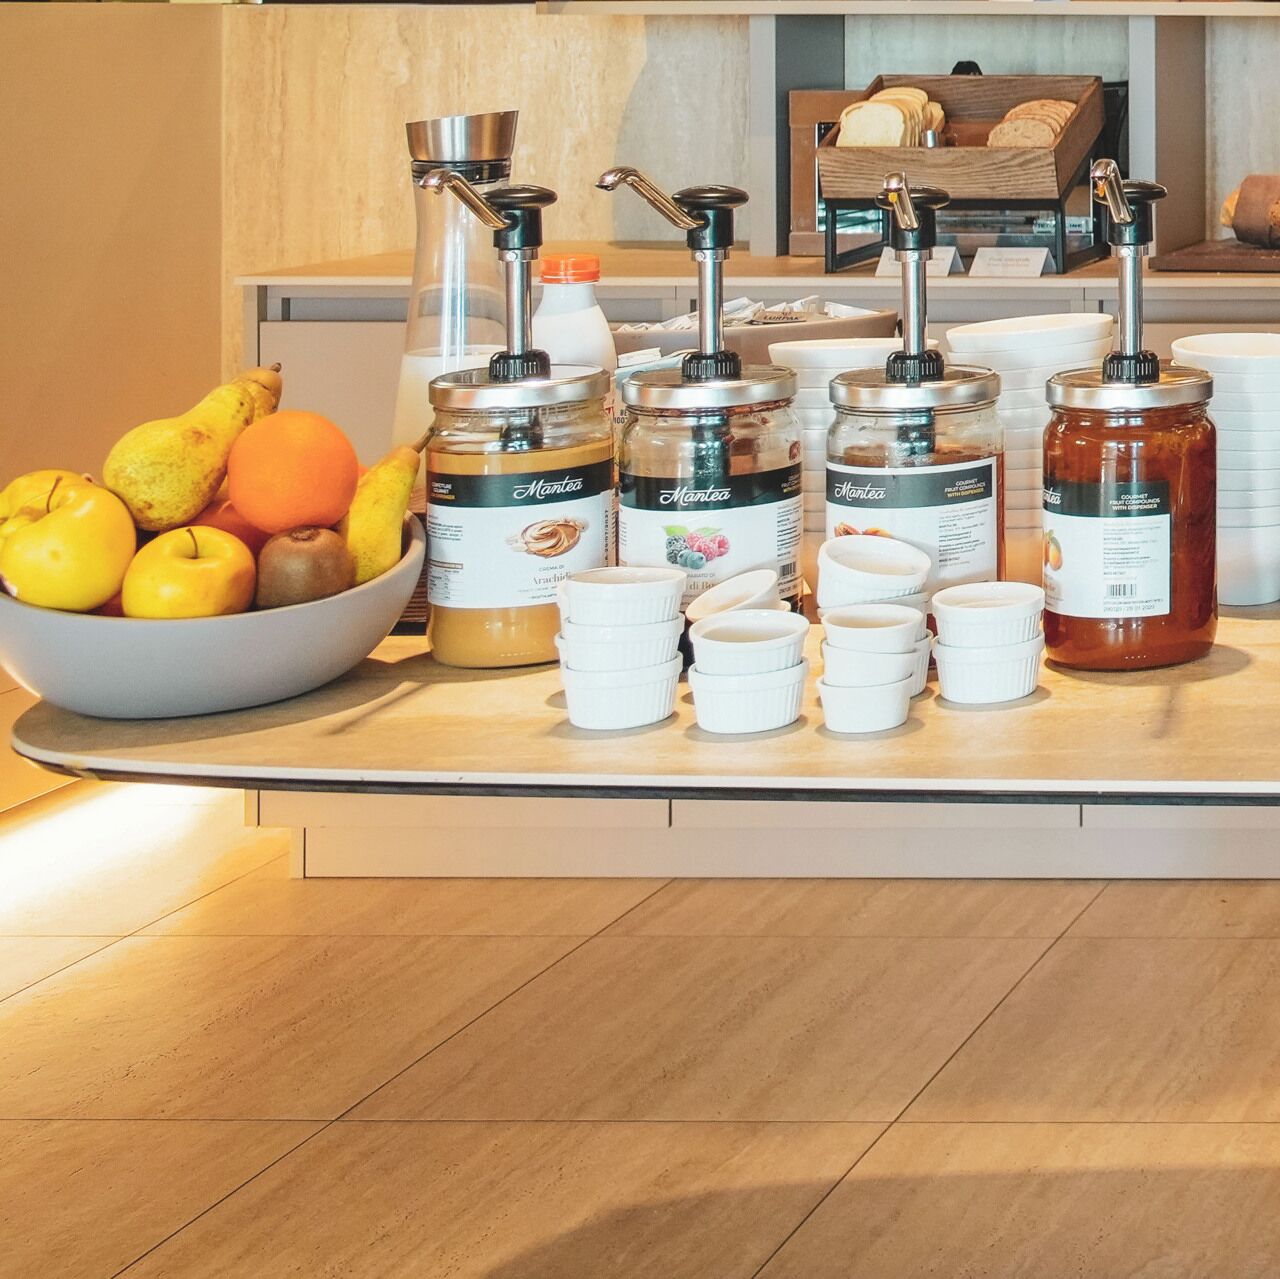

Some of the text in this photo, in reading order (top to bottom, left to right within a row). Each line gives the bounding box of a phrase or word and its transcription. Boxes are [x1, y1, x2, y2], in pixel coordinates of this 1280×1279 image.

[513, 476, 584, 499] Mantea
[834, 481, 886, 501] Mantea
[955, 478, 978, 486] GOURMET
[659, 484, 731, 506] Mantea
